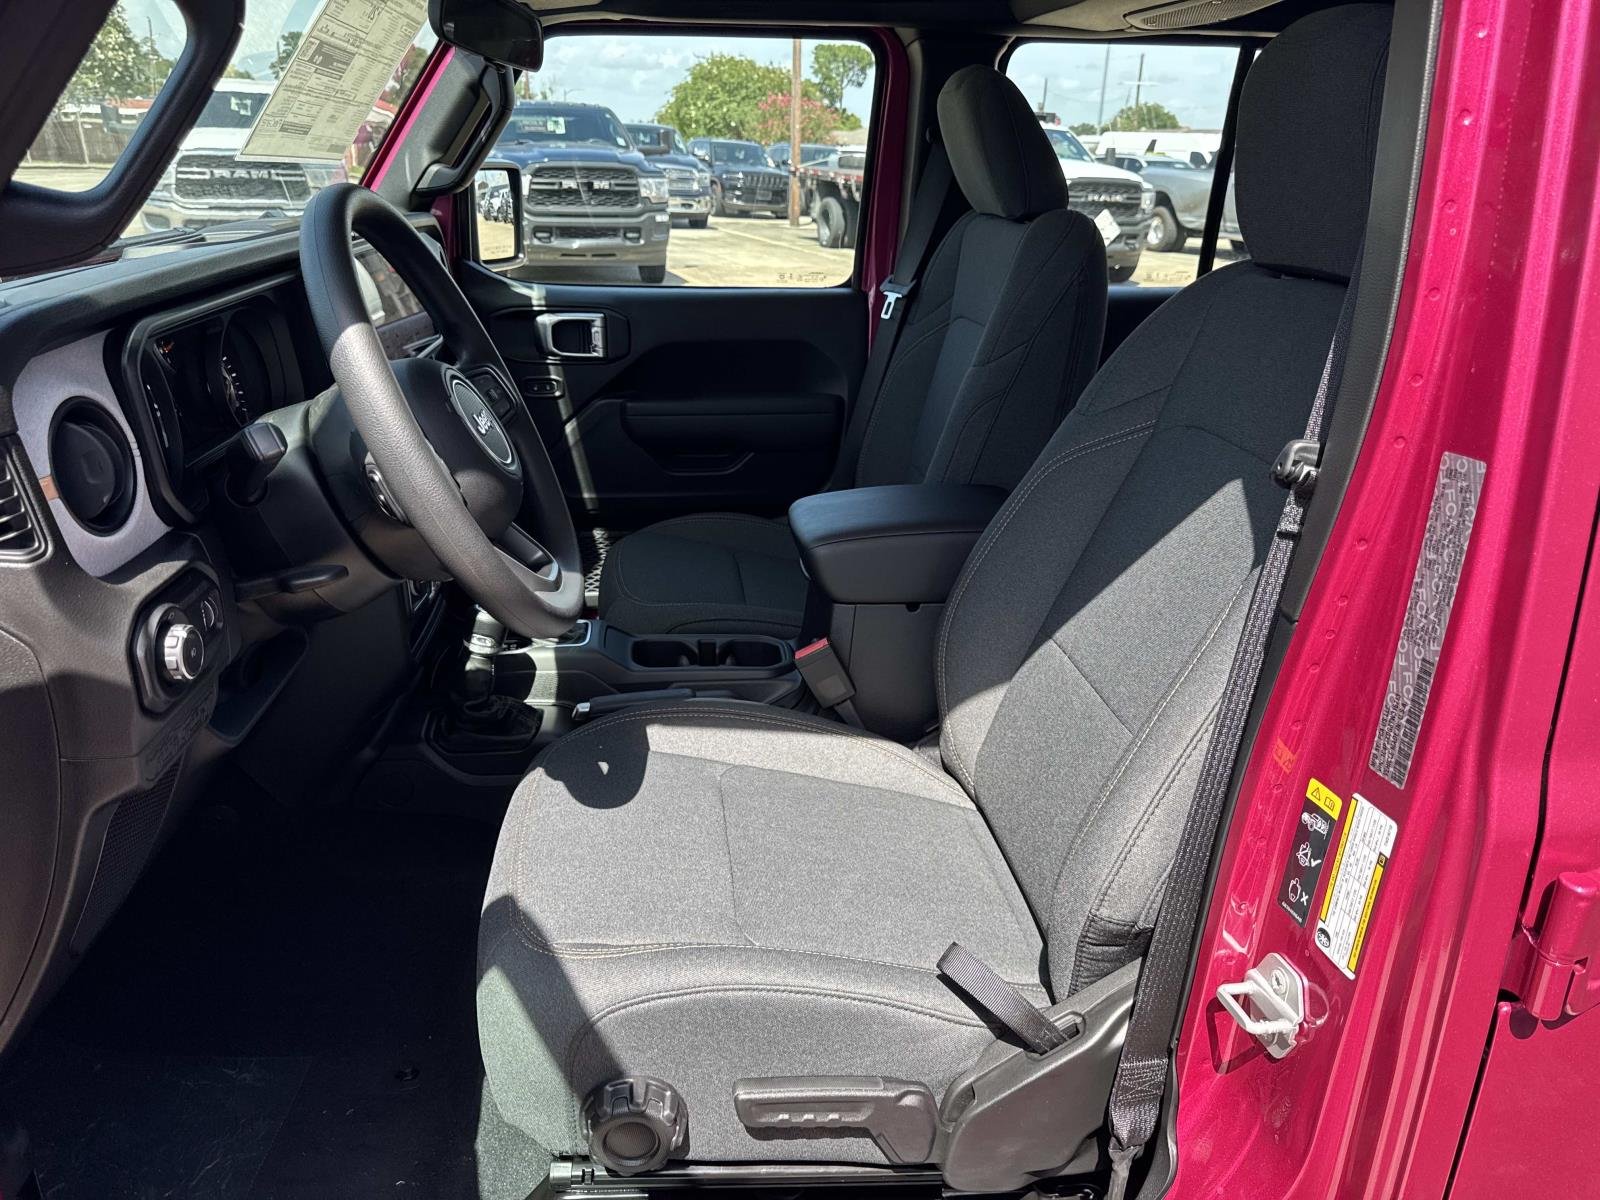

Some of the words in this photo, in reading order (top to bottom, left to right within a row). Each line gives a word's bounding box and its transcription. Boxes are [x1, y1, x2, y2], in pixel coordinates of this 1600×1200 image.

[213, 169, 269, 179] RAM
[561, 179, 610, 190] RM
[473, 410, 492, 434] Jeep
